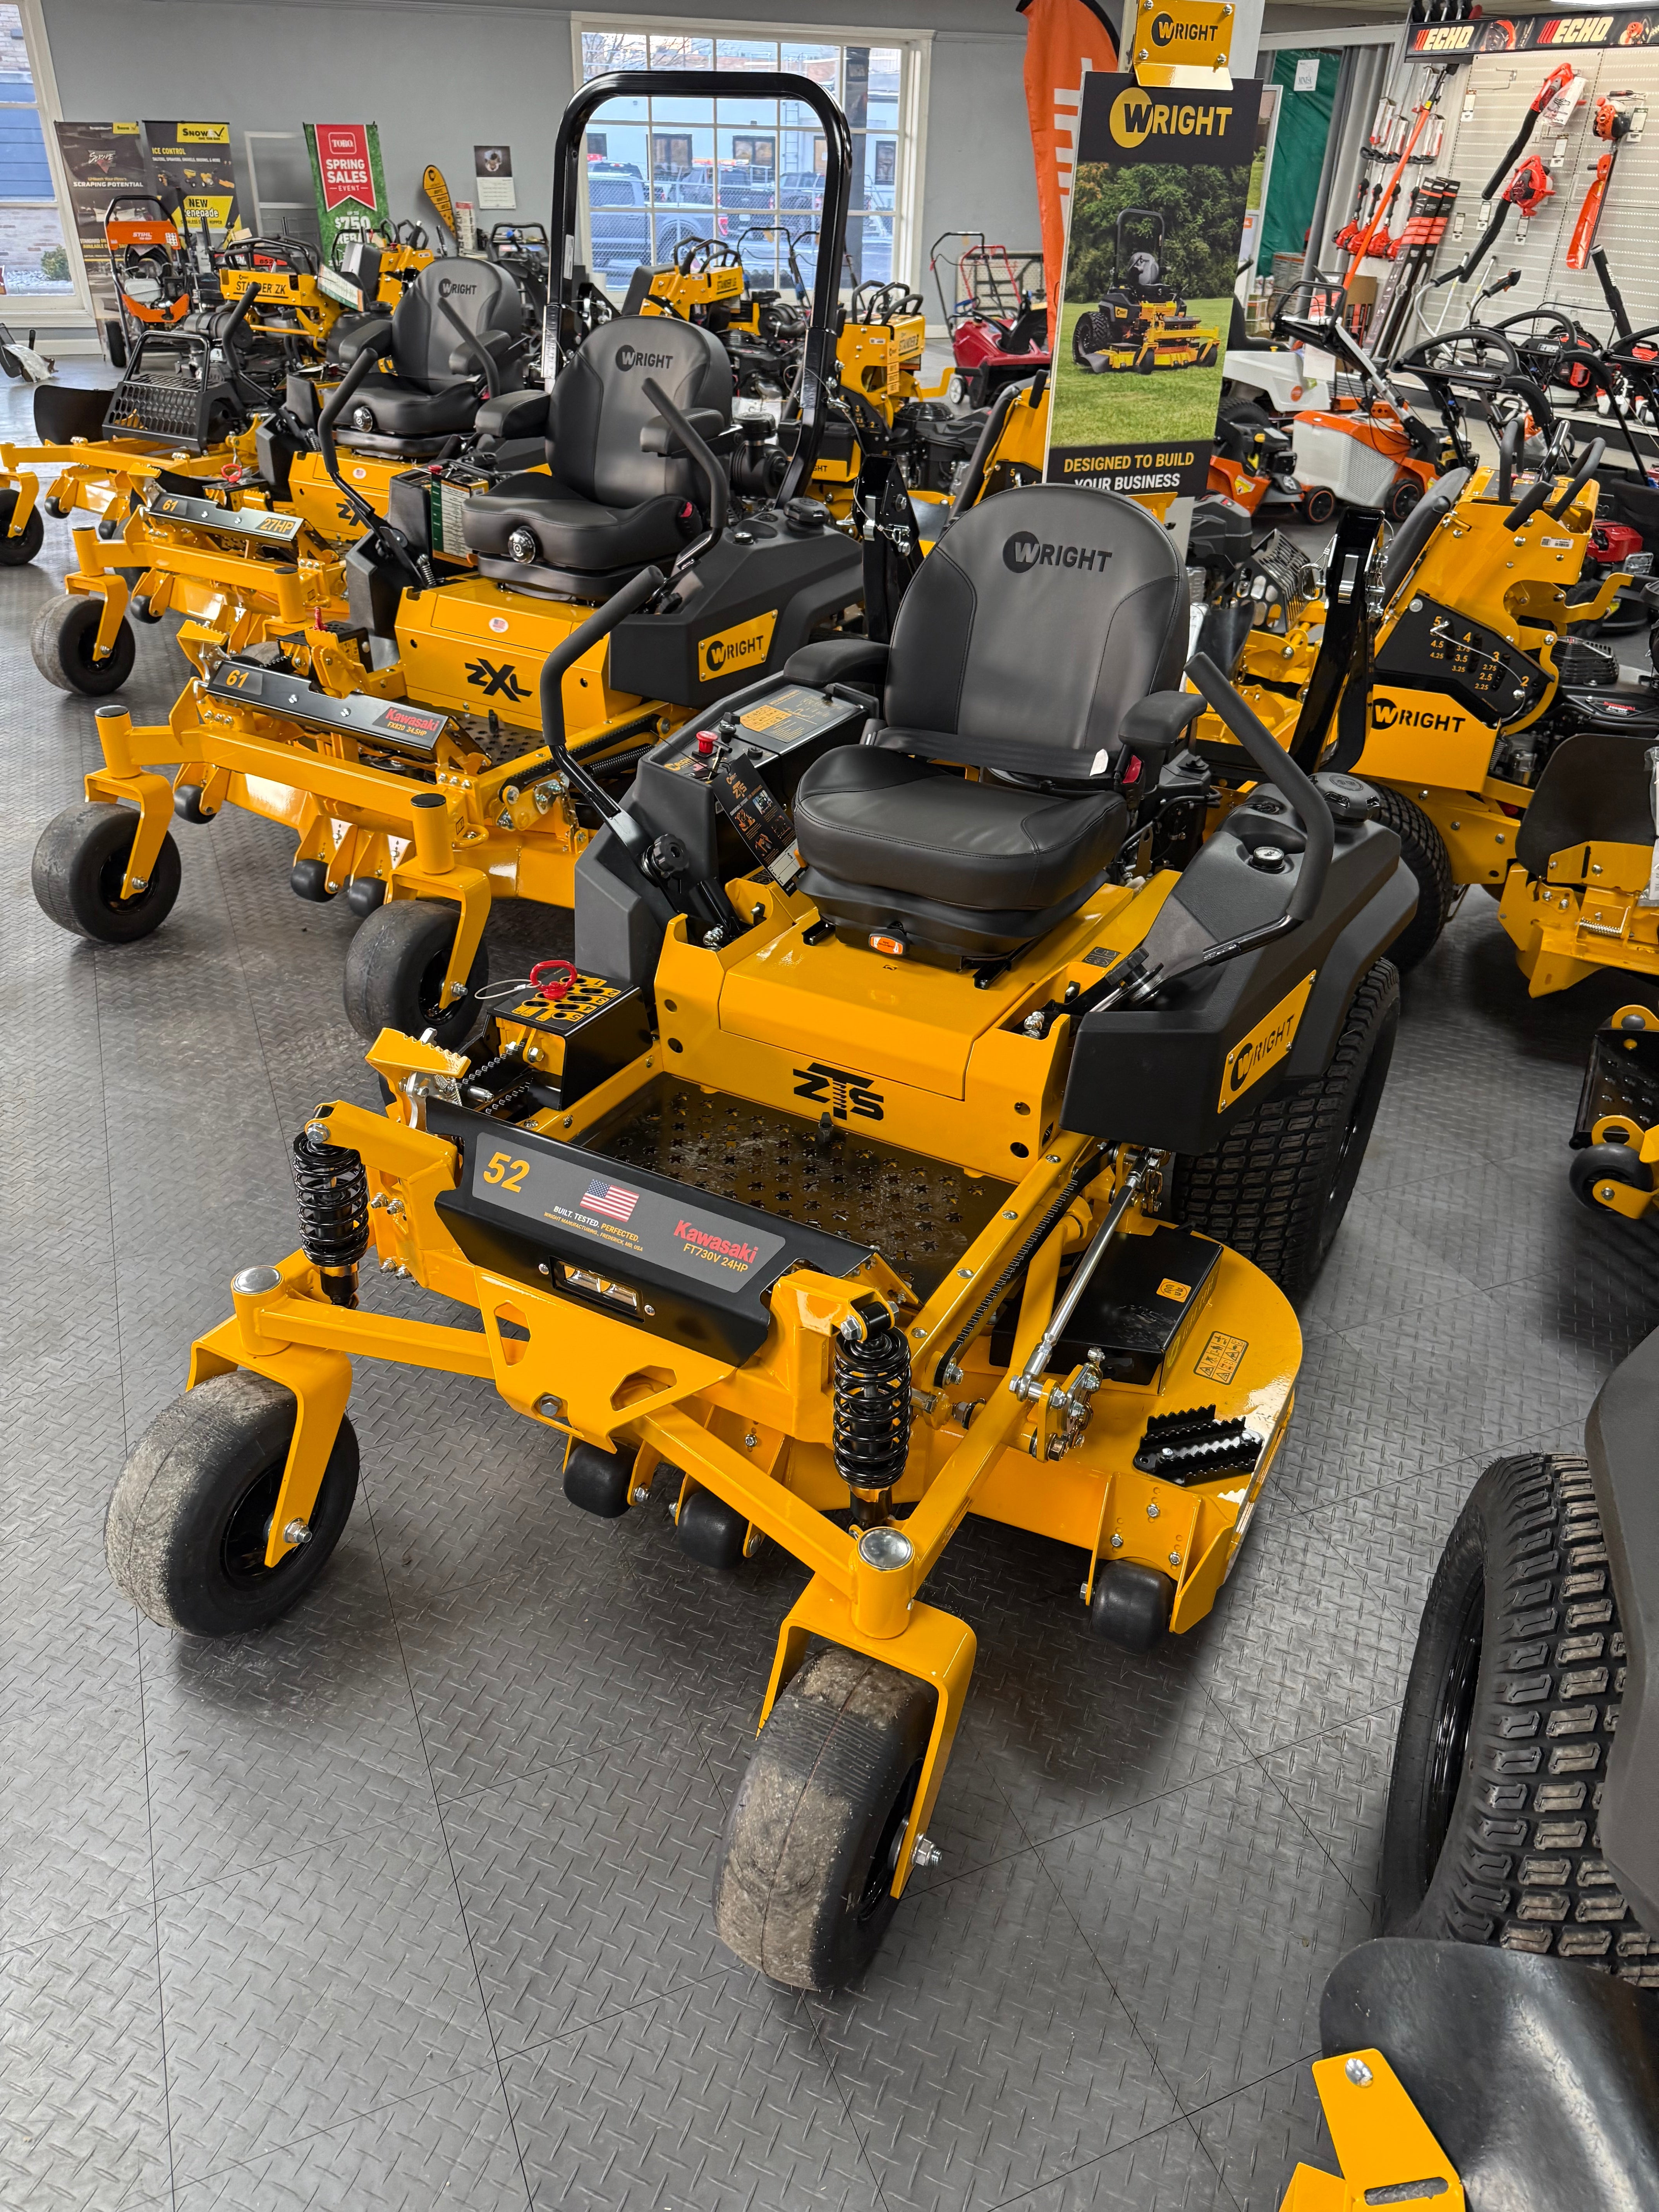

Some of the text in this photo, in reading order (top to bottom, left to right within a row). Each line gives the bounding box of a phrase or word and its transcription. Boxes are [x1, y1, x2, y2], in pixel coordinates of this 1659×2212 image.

[1155, 17, 1218, 43] WRIGHT
[1552, 17, 1614, 43] ECHO
[1422, 26, 1475, 50] ECHO
[1117, 96, 1232, 141] WRIGHT
[326, 159, 365, 170] SPRING
[327, 171, 368, 183] SALES
[189, 199, 208, 208] NEW
[185, 208, 218, 218] enegade
[335, 216, 371, 230] $750
[275, 284, 287, 295] ZK
[441, 282, 477, 297] WRIGHT
[619, 348, 673, 370] WRIGHT
[1064, 452, 1194, 473] DESIGNED TO BUILD
[1010, 468, 1015, 477] 5
[1074, 473, 1180, 490] YOUR BUSINESS
[162, 500, 179, 512] 61
[263, 518, 295, 533] 27HP
[1008, 536, 1112, 572] WRIGHT
[1433, 616, 1442, 626] 5
[1430, 640, 1444, 649] 4.5
[1463, 632, 1471, 643] 4
[709, 635, 764, 667] WRIGHT
[1455, 654, 1468, 663] 3.5
[1491, 651, 1499, 662] 3
[226, 670, 250, 688] 61
[1479, 673, 1493, 681] 2.5
[1520, 676, 1529, 687] 2
[385, 708, 440, 732] Kawasaki
[1373, 701, 1466, 732] WRIGHT
[1234, 1013, 1295, 1086] WRIGHT
[483, 1152, 530, 1193] 52
[544, 1212, 562, 1221] WRIGHT
[553, 1206, 639, 1242] BUILT. TESTED. PERFECTED.
[674, 1220, 759, 1263] Kawasaki
[683, 1243, 748, 1273] FT730V 24HP
